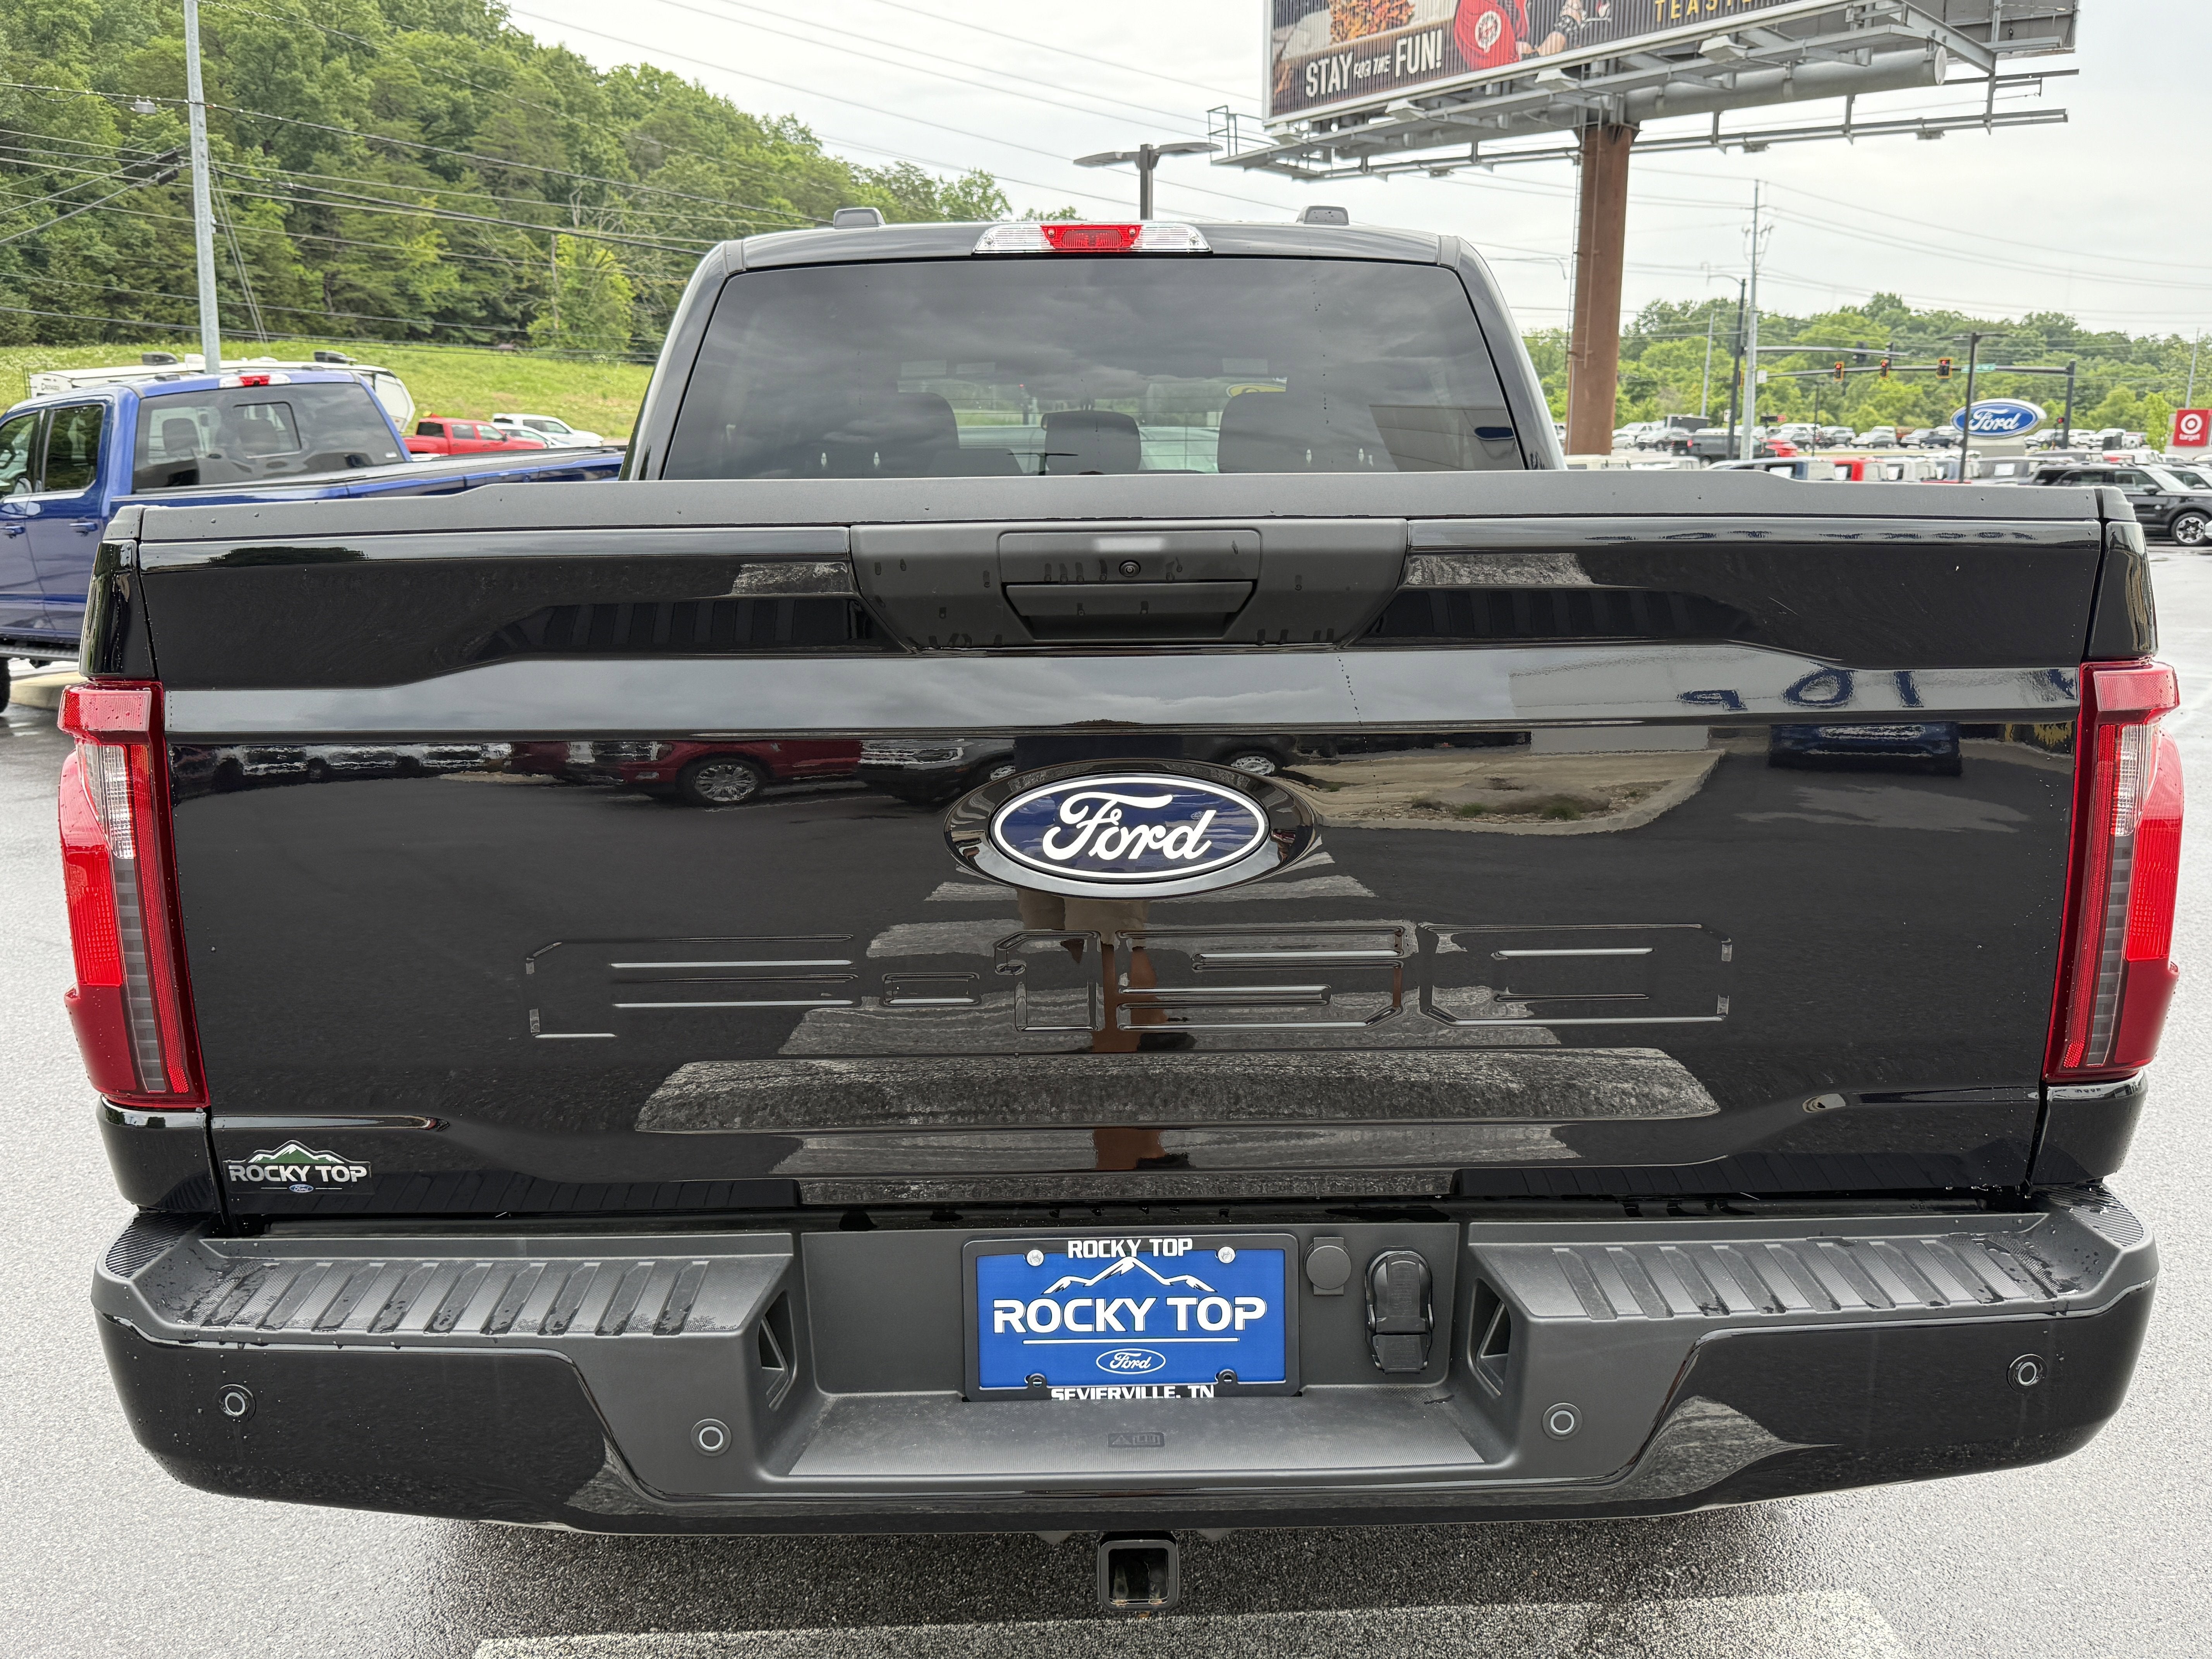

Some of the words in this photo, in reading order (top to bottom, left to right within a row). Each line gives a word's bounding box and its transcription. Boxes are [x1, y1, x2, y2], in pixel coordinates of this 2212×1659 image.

[1305, 51, 1353, 97] STAY
[1396, 29, 1442, 77] FUN!
[1968, 408, 2022, 431] Ford
[1042, 791, 1216, 860] Ford
[228, 1165, 311, 1182] ROCKY
[315, 1166, 368, 1182] TOP
[1068, 1239, 1142, 1258] ROCKY
[1149, 1238, 1193, 1257] TOP
[993, 1298, 1157, 1334] ROCKY
[1166, 1297, 1267, 1331] TOP
[1109, 1352, 1152, 1369] Ford
[1187, 1385, 1214, 1398] TN
